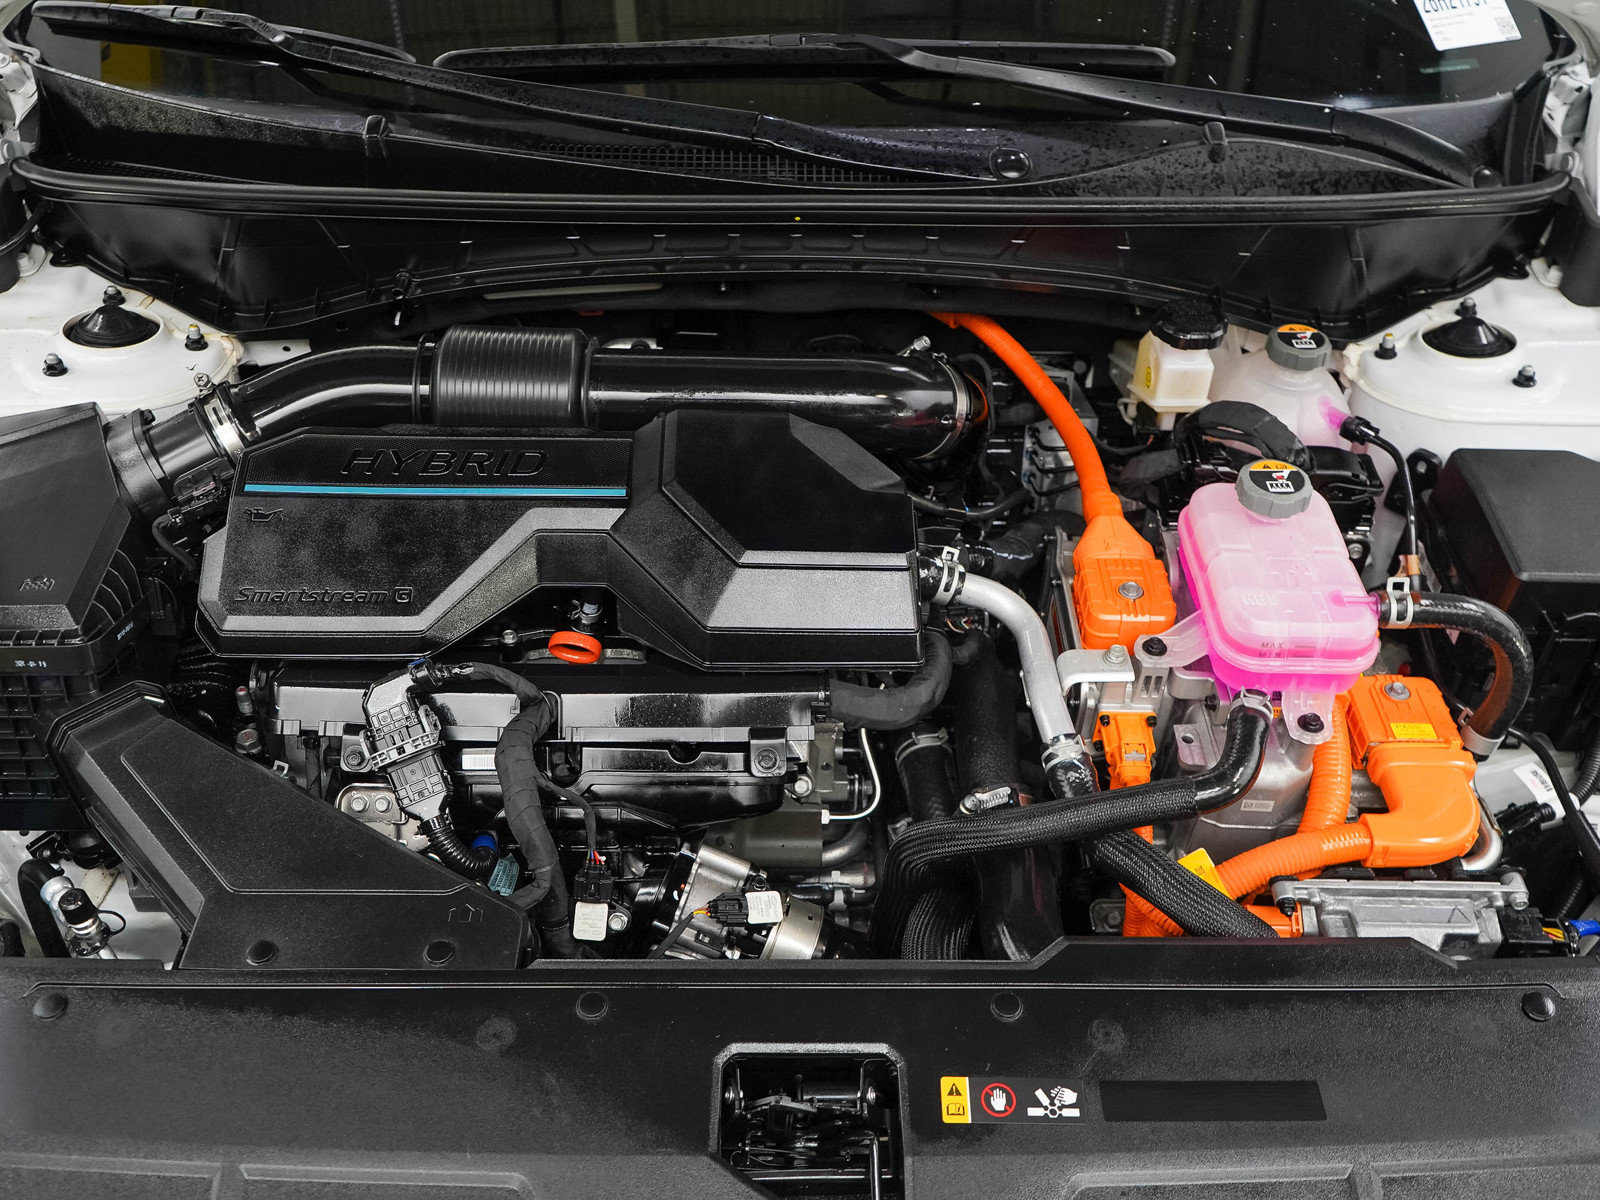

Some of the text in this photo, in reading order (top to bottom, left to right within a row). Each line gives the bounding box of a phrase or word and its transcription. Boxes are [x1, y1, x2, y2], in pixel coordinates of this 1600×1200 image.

[340, 449, 548, 477] HYBRID
[235, 586, 388, 603] Smartstream
[1260, 641, 1284, 649] MAX
